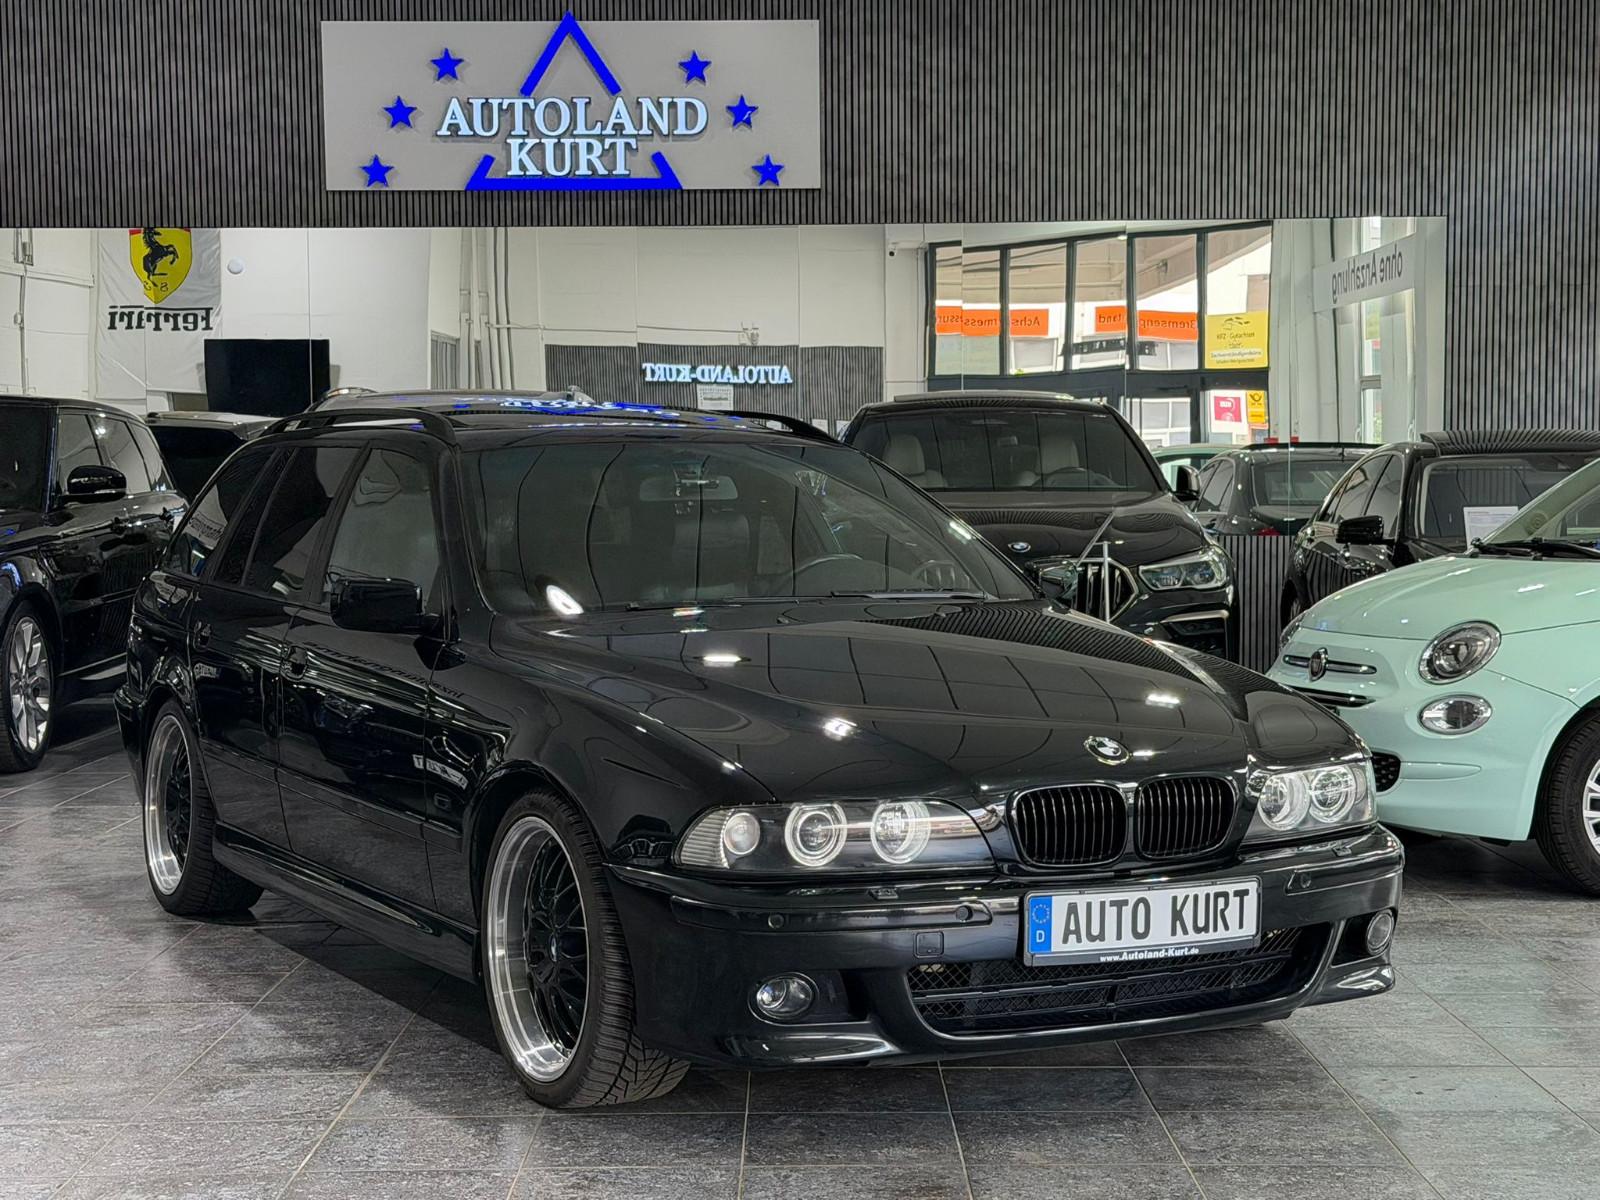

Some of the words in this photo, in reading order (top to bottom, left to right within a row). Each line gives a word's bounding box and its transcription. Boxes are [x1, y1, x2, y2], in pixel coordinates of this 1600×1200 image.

[437, 97, 708, 137] AUTOLAND
[506, 138, 639, 177] KURT
[1062, 896, 1151, 944] AUTO
[1170, 888, 1250, 937] KURT
[1036, 930, 1045, 943] D
[1100, 947, 1199, 962] www.Autoland-Kurt.de
